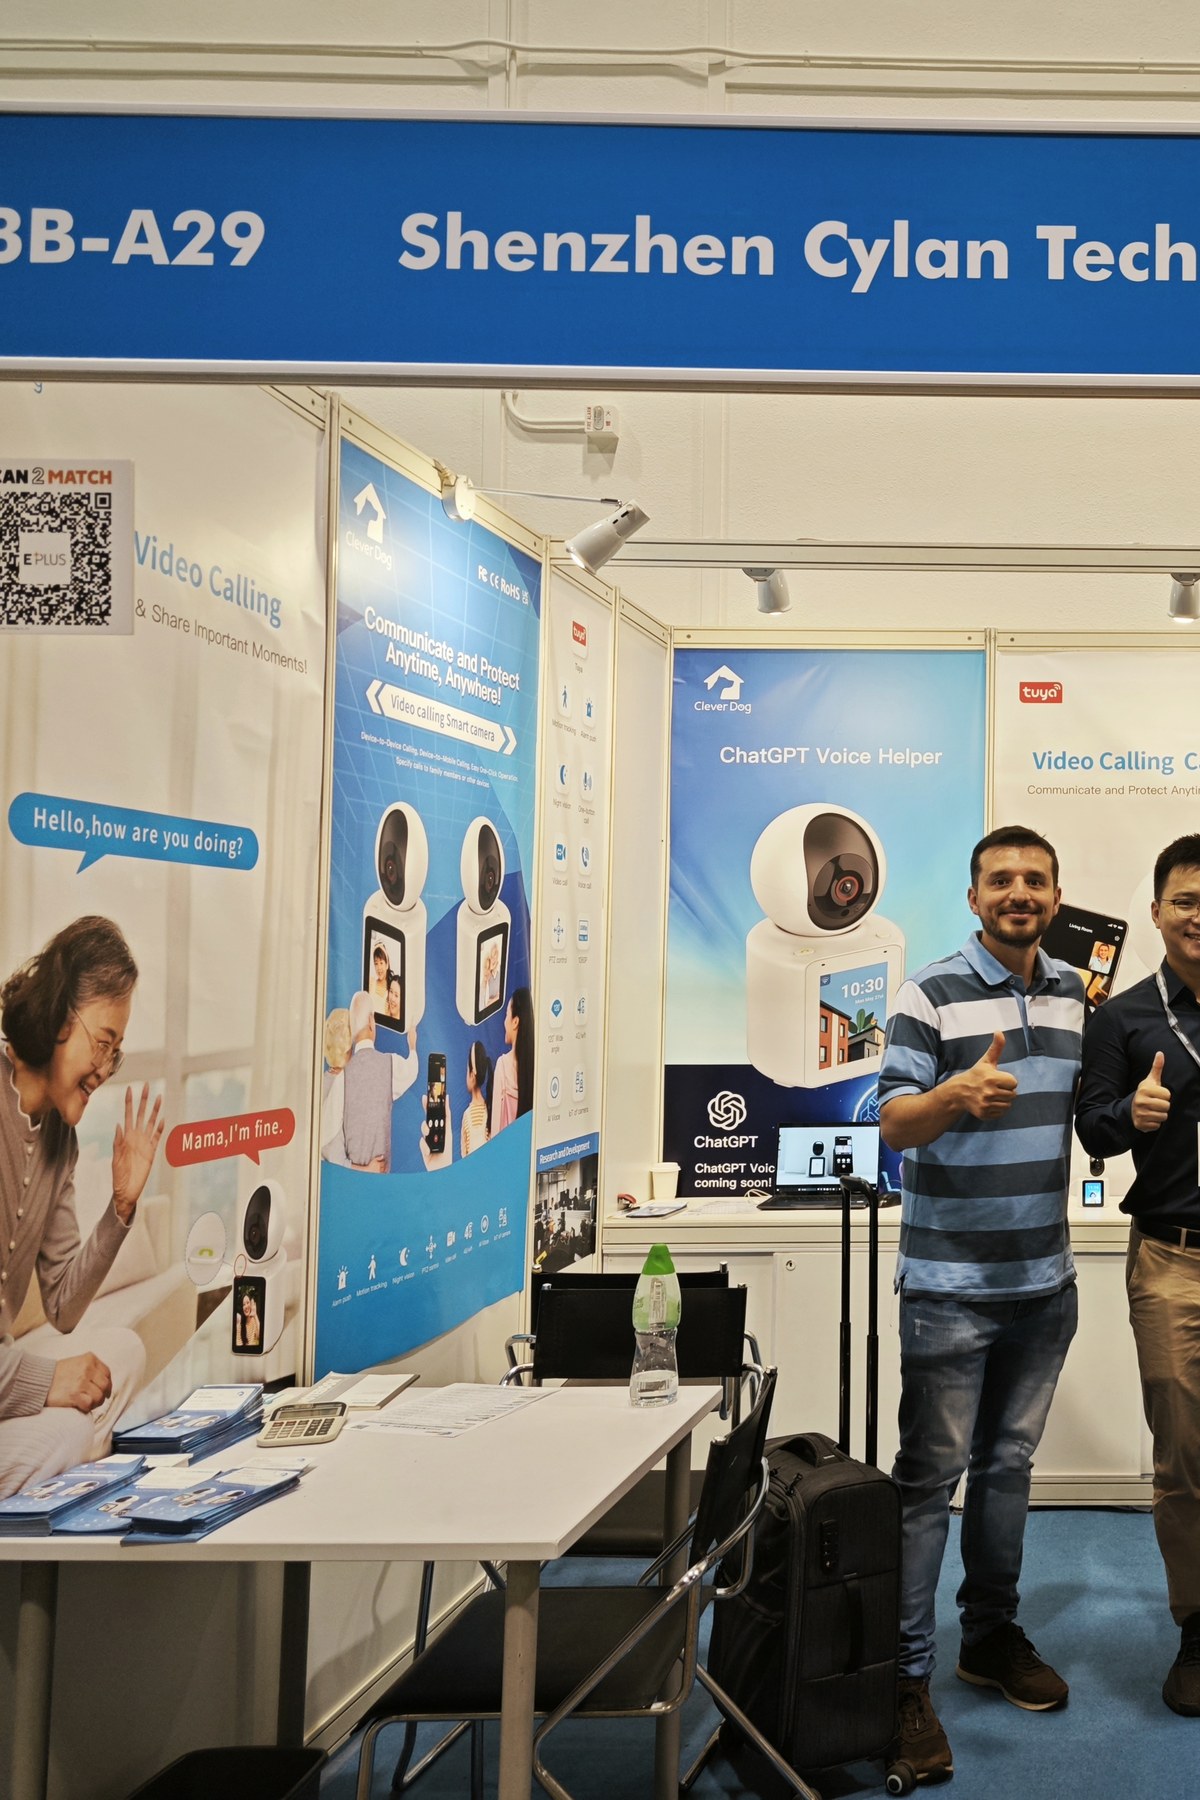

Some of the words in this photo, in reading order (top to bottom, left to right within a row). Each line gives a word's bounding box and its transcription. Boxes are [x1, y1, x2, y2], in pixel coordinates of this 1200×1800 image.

[399, 211, 774, 275] Shenzhen
[803, 219, 1009, 293] Cylan
[0, 470, 28, 484] AN
[32, 467, 45, 485] 2
[48, 470, 112, 484] MATCH
[345, 530, 374, 560] Clever
[374, 544, 392, 571] Dog
[134, 530, 202, 588] Video
[209, 565, 282, 629] Calling
[501, 579, 521, 601] RoHS
[135, 598, 146, 618] &
[152, 604, 190, 632] Share
[194, 618, 249, 656] Important
[252, 641, 307, 674] Moments!
[364, 606, 455, 664] Communicate
[457, 648, 478, 673] and
[480, 657, 520, 691] Protect
[386, 642, 443, 686] Anytime,
[445, 668, 502, 706] Anywhere!
[1022, 686, 1057, 701] tuya
[390, 694, 415, 717] Video
[416, 702, 445, 728] calling
[446, 710, 469, 735] Smart
[470, 724, 495, 743] camera
[694, 701, 728, 712] Clever
[729, 701, 752, 714] Dog
[720, 746, 809, 764] ChatGPT
[816, 747, 871, 765] Voice
[879, 747, 942, 768] Helper
[1033, 751, 1094, 770] Video
[1100, 751, 1174, 775] Calling
[1027, 785, 1101, 796] Communicate
[1104, 785, 1125, 796] and
[1128, 785, 1168, 796] Protect
[34, 807, 126, 839] Hello,how
[132, 826, 158, 844] are
[163, 831, 189, 850] you
[194, 831, 243, 858] doing?
[841, 976, 884, 999] 10:30
[181, 1125, 250, 1152] Mama,I'm
[254, 1118, 283, 1139] fine.
[694, 1135, 758, 1149] ChatGPT
[540, 1149, 558, 1165] Research
[558, 1146, 566, 1159] and
[566, 1140, 591, 1155] Development
[694, 1163, 747, 1174] ChatGPT
[749, 1163, 775, 1174] Voic
[694, 1178, 736, 1189] coming
[740, 1178, 772, 1188] soon!
